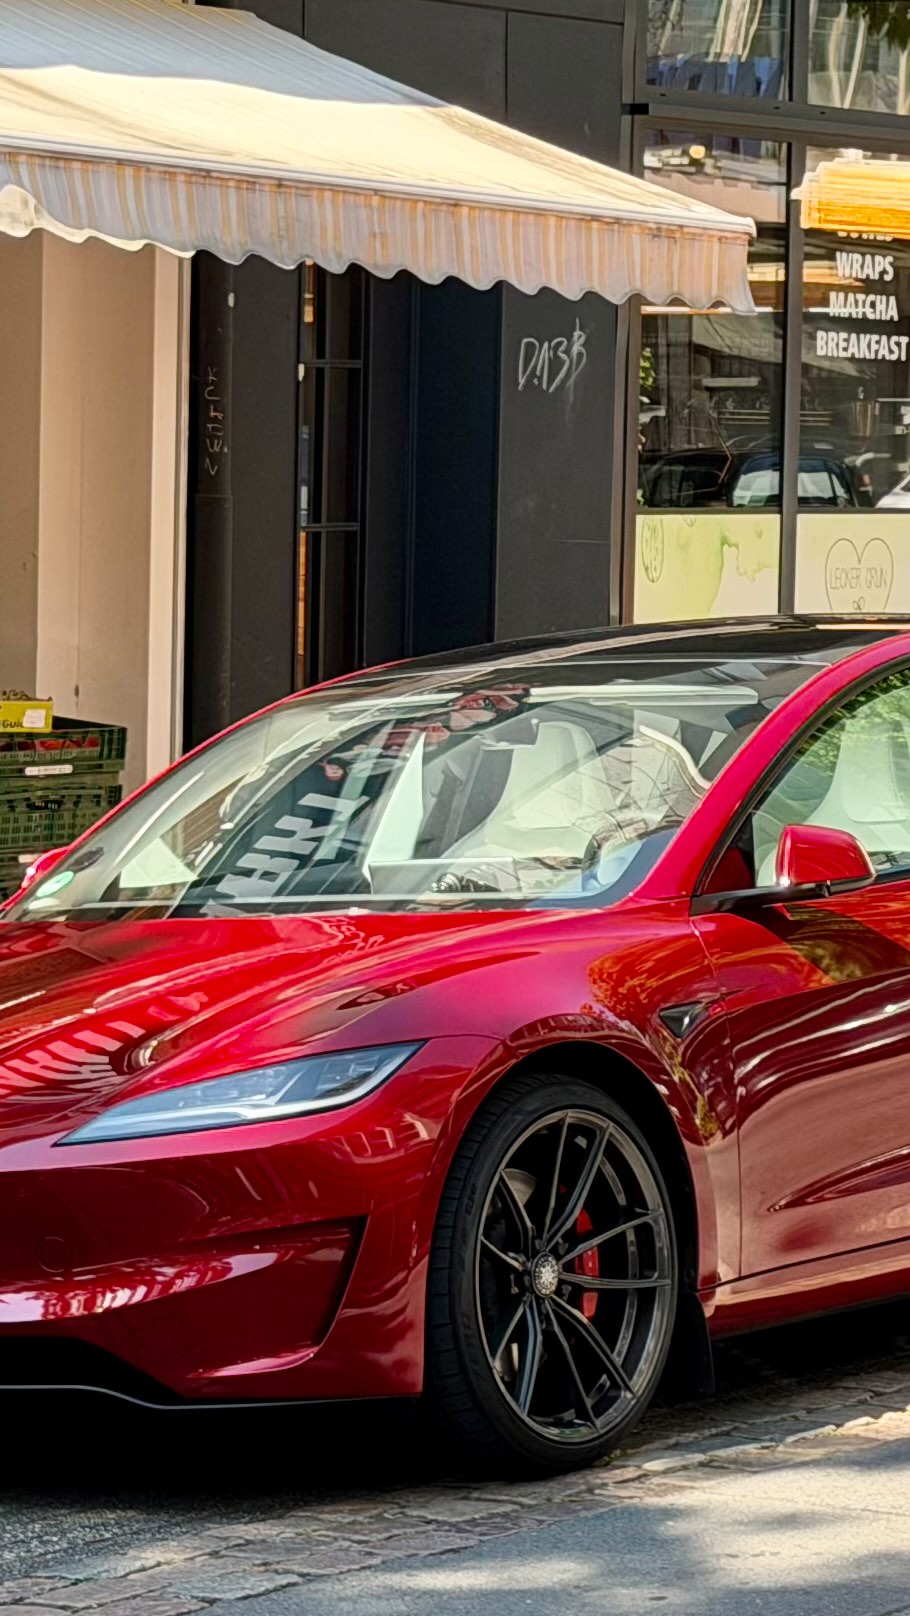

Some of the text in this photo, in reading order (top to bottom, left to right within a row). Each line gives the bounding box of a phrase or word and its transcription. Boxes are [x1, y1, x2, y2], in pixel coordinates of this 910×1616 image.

[835, 251, 894, 282] WRAPS
[829, 291, 899, 321] MATCHA
[816, 330, 909, 361] BREAKFAST
